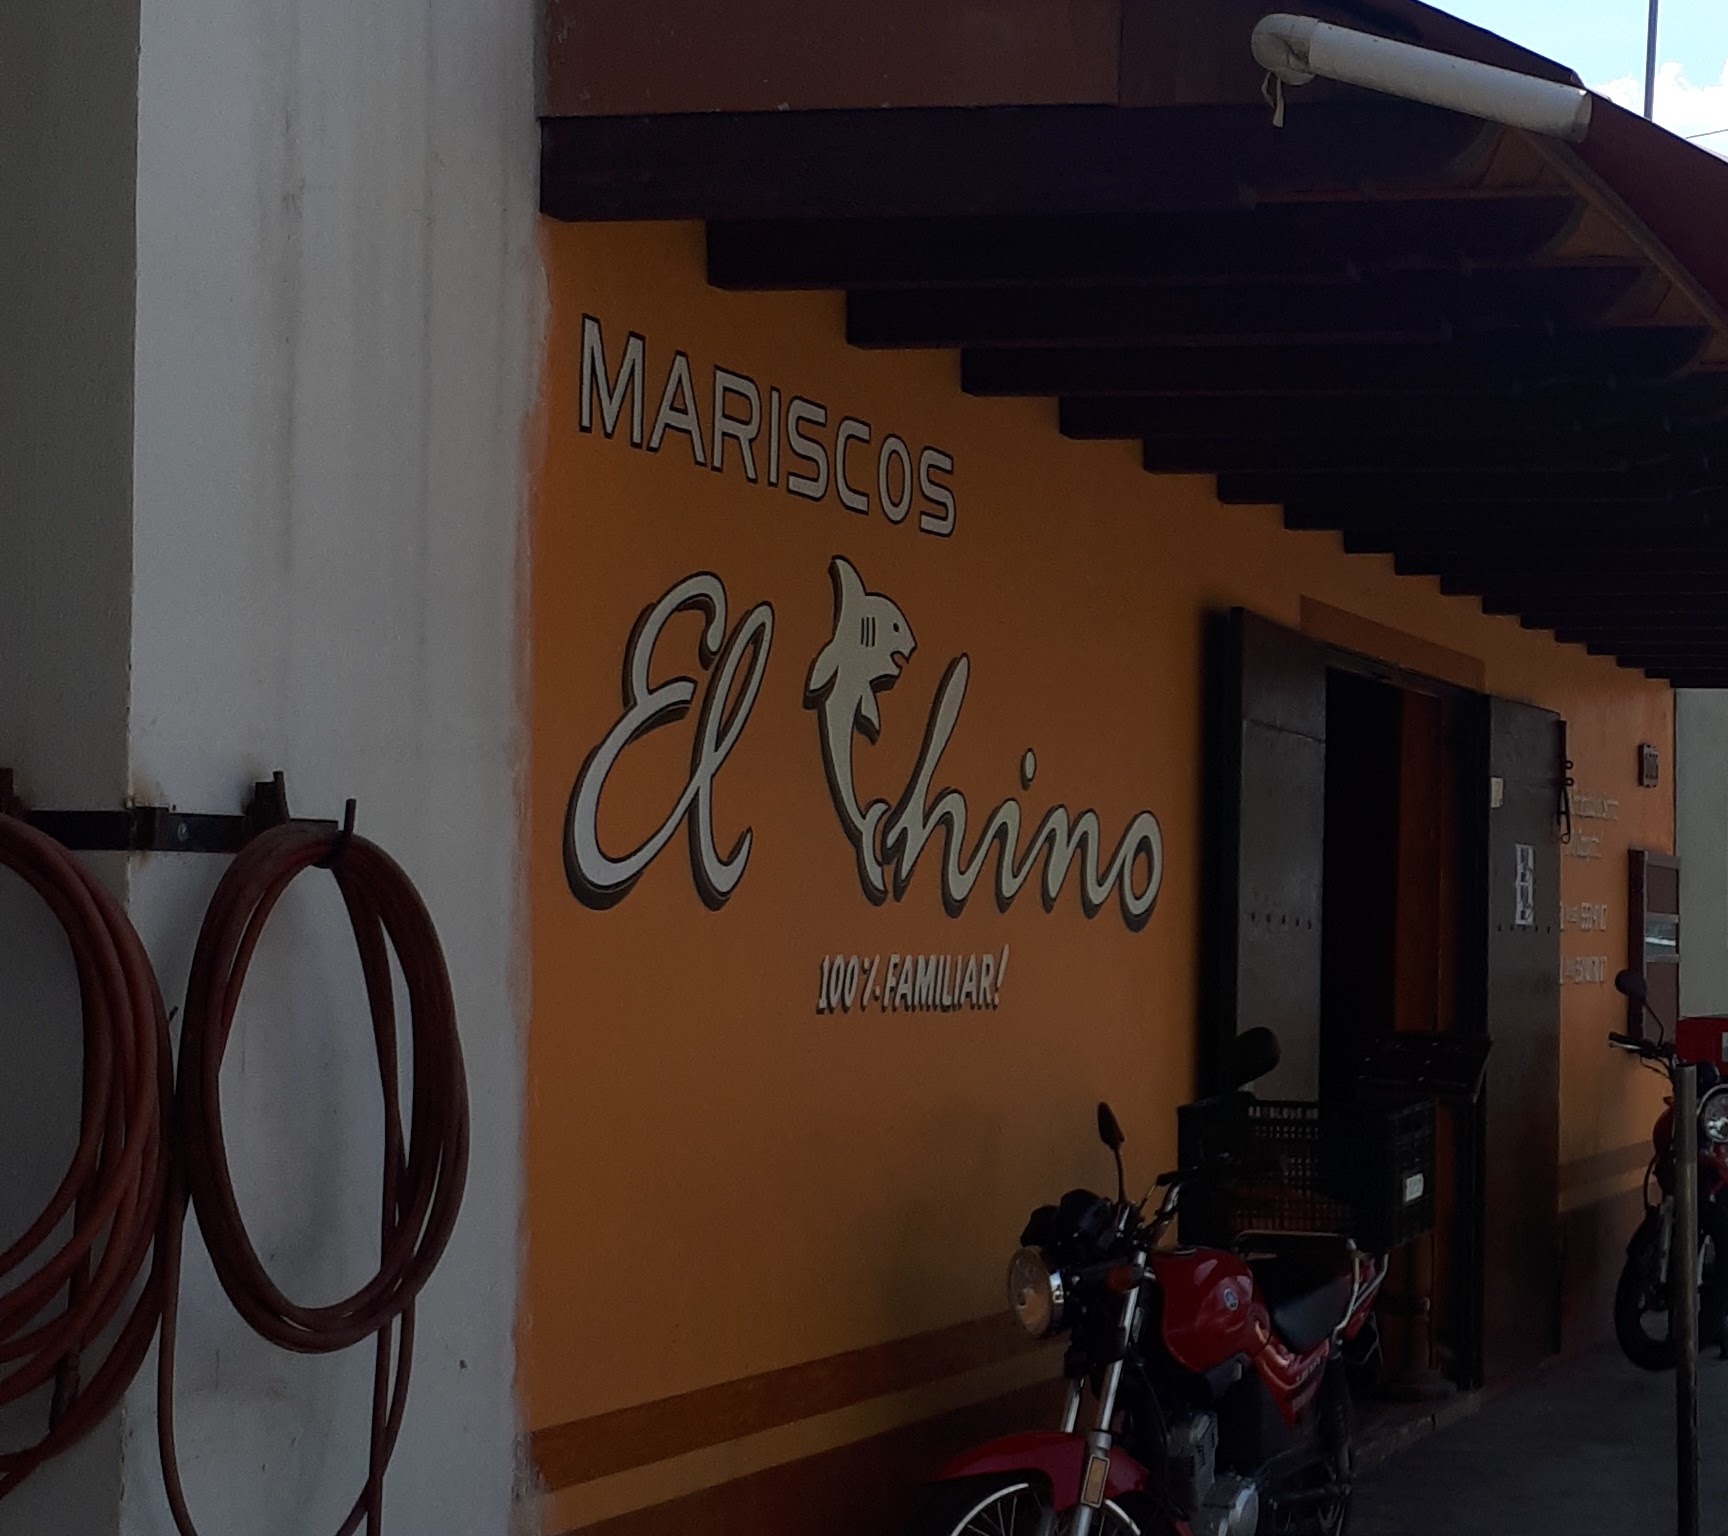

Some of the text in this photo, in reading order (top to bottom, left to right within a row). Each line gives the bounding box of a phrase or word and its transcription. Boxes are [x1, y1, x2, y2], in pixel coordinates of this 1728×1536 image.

[579, 314, 957, 536] MARISCOS
[563, 570, 775, 911] El
[817, 943, 1010, 1014] 100% FAMILIAR!
